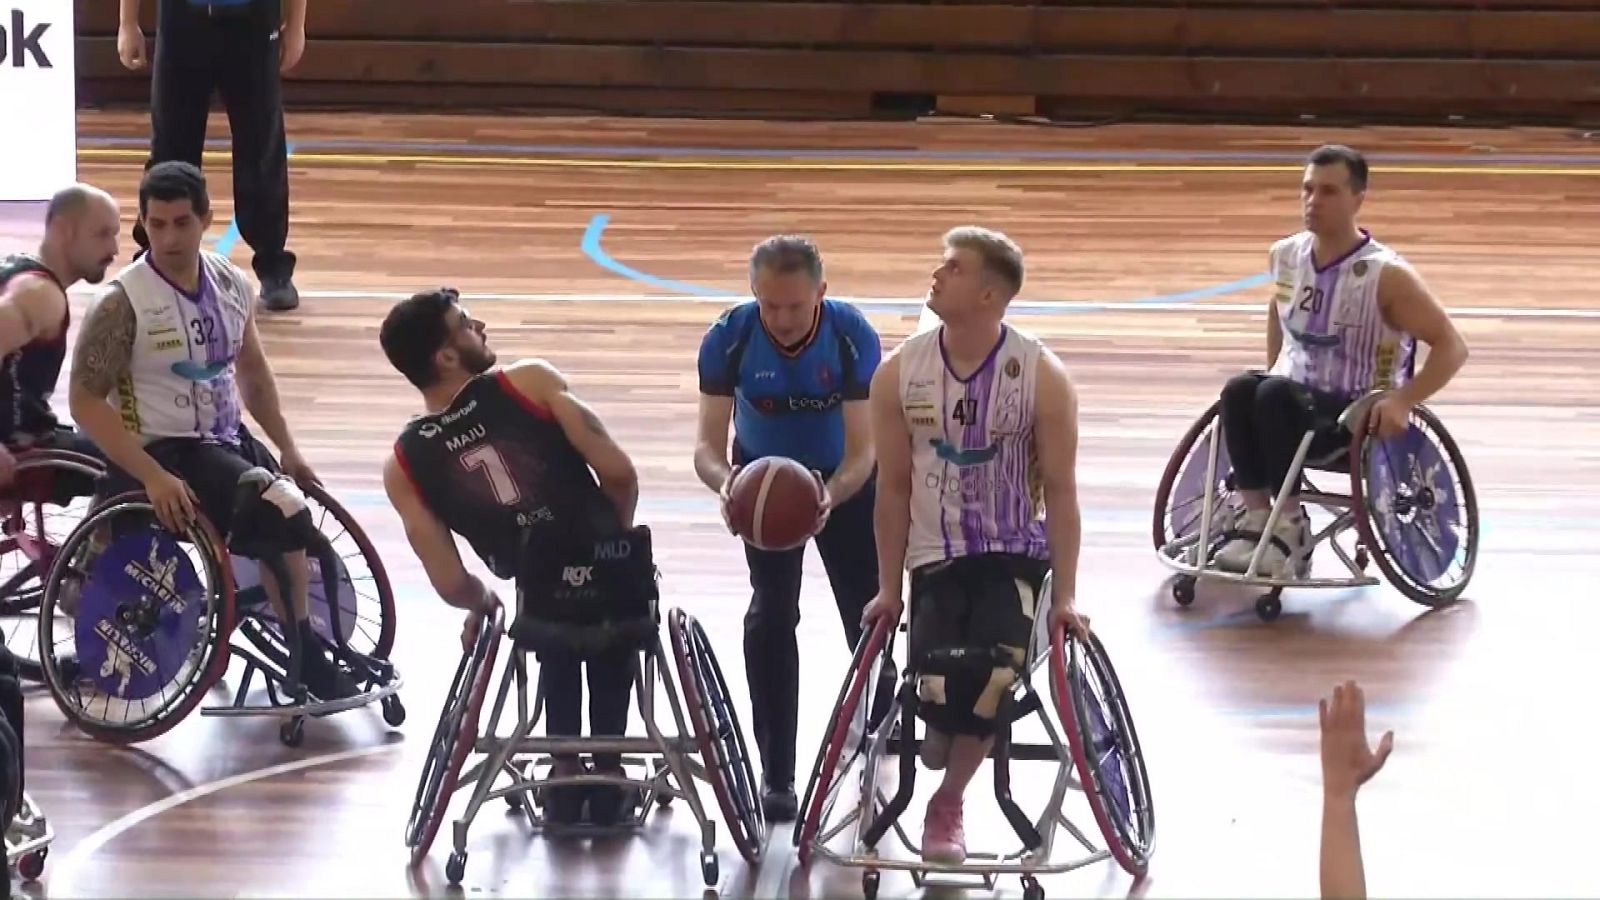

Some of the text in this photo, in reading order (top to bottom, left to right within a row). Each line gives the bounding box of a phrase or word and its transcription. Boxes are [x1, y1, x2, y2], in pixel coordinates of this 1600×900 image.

[1300, 286, 1324, 314] 20
[190, 316, 218, 345] 32
[952, 399, 978, 426] 40
[460, 444, 521, 506] 7
[124, 562, 185, 614] MICHELIN
